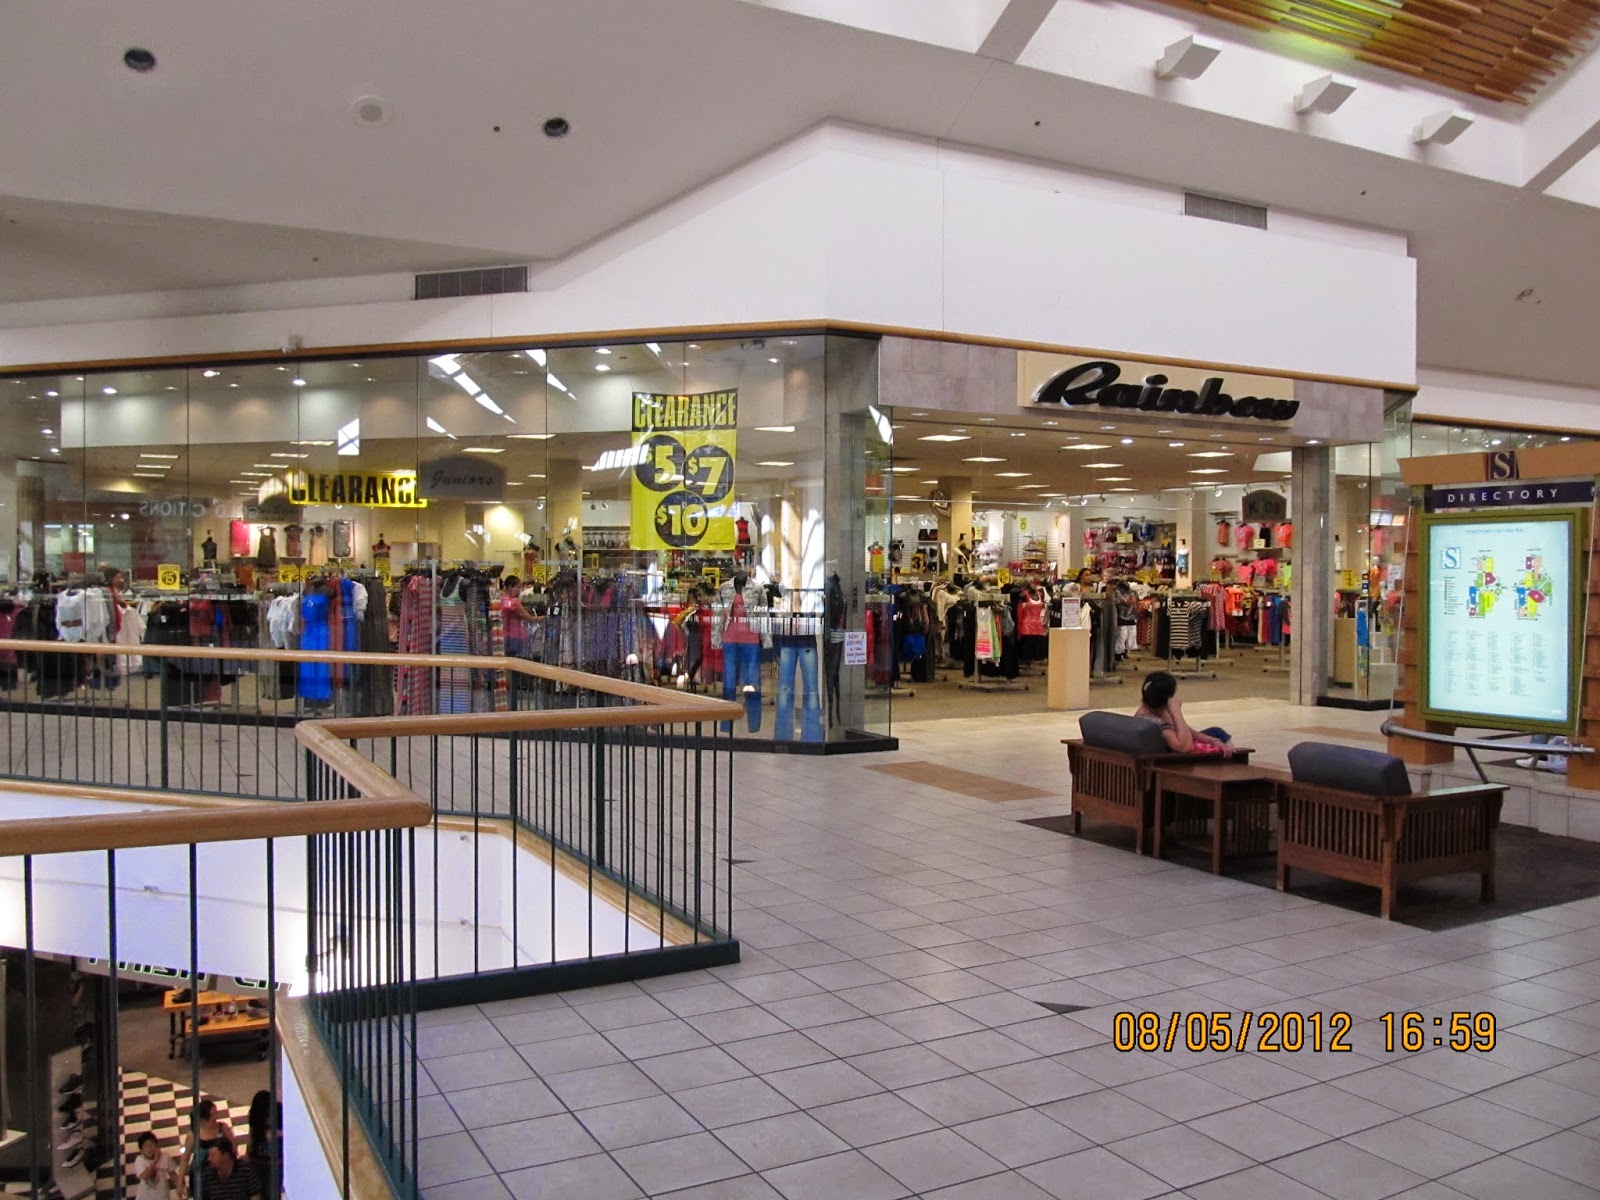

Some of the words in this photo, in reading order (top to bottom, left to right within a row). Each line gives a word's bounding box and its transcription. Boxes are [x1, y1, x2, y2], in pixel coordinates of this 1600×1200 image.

[1034, 361, 1300, 420] Rainbow
[634, 391, 737, 428] CLEARANCE
[430, 469, 494, 489] Juniors
[687, 456, 728, 495] $7
[1493, 451, 1511, 480] S
[1246, 499, 1281, 514] KIDS
[1447, 488, 1559, 503] DIRECTORY
[656, 503, 706, 537] $10
[1444, 546, 1458, 570] S
